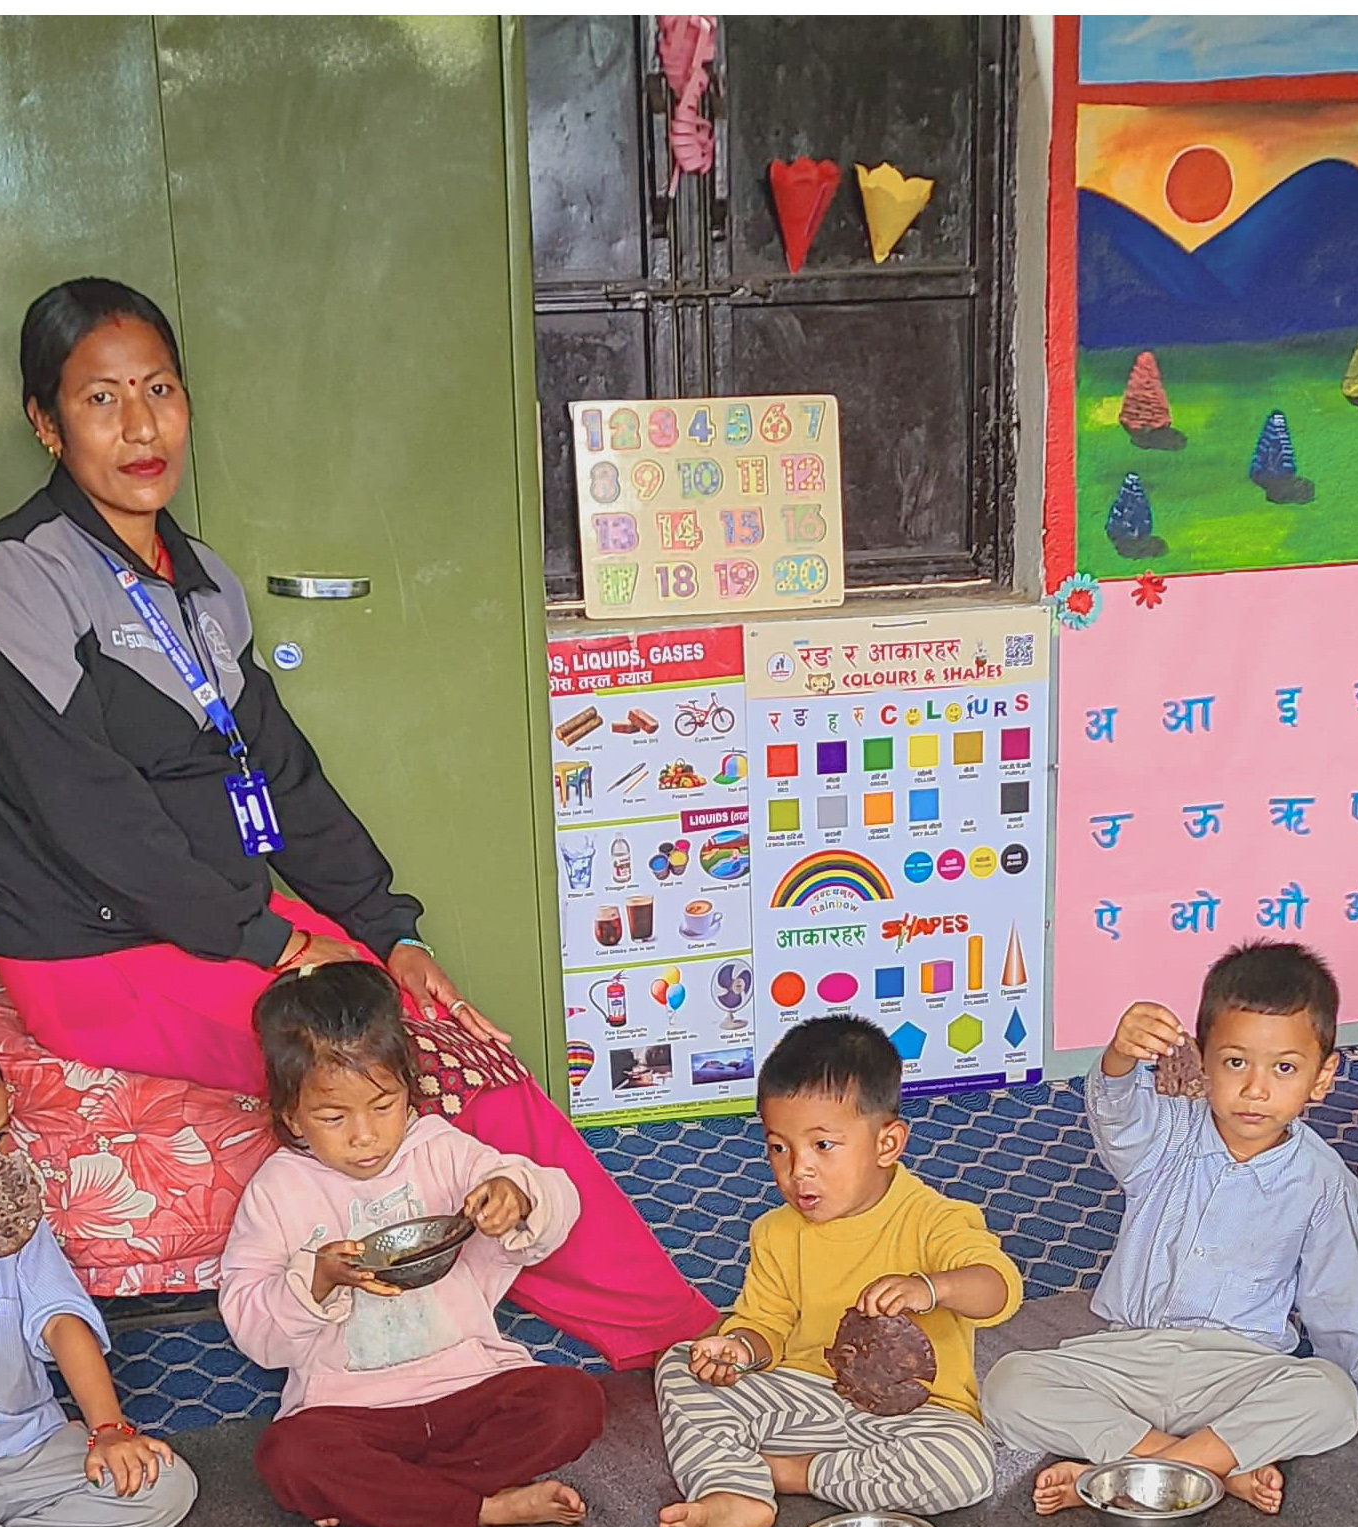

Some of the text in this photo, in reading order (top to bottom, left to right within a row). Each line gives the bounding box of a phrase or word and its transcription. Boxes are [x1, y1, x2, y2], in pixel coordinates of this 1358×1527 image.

[582, 402, 825, 450] 1 2 3 4 5 6 7
[590, 454, 824, 503] 8 9 10 11 12
[593, 504, 826, 552] 13 14 15 16
[654, 562, 698, 600] 18
[713, 558, 758, 599] 19
[773, 555, 828, 596] 20
[650, 643, 705, 664] GASES
[842, 663, 1004, 688] COLOURS & SHAPES
[843, 644, 858, 668] र
[1086, 706, 1118, 743] अ
[1163, 694, 1216, 733] आ
[1275, 685, 1304, 727] इ
[689, 811, 729, 826] LIQUIDS
[1090, 812, 1134, 849] उ
[1183, 802, 1225, 839] ऊ
[1270, 796, 1316, 836] ऋ
[1094, 899, 1122, 941] ऐ
[1171, 889, 1221, 933] ओ
[1257, 881, 1310, 930] औ
